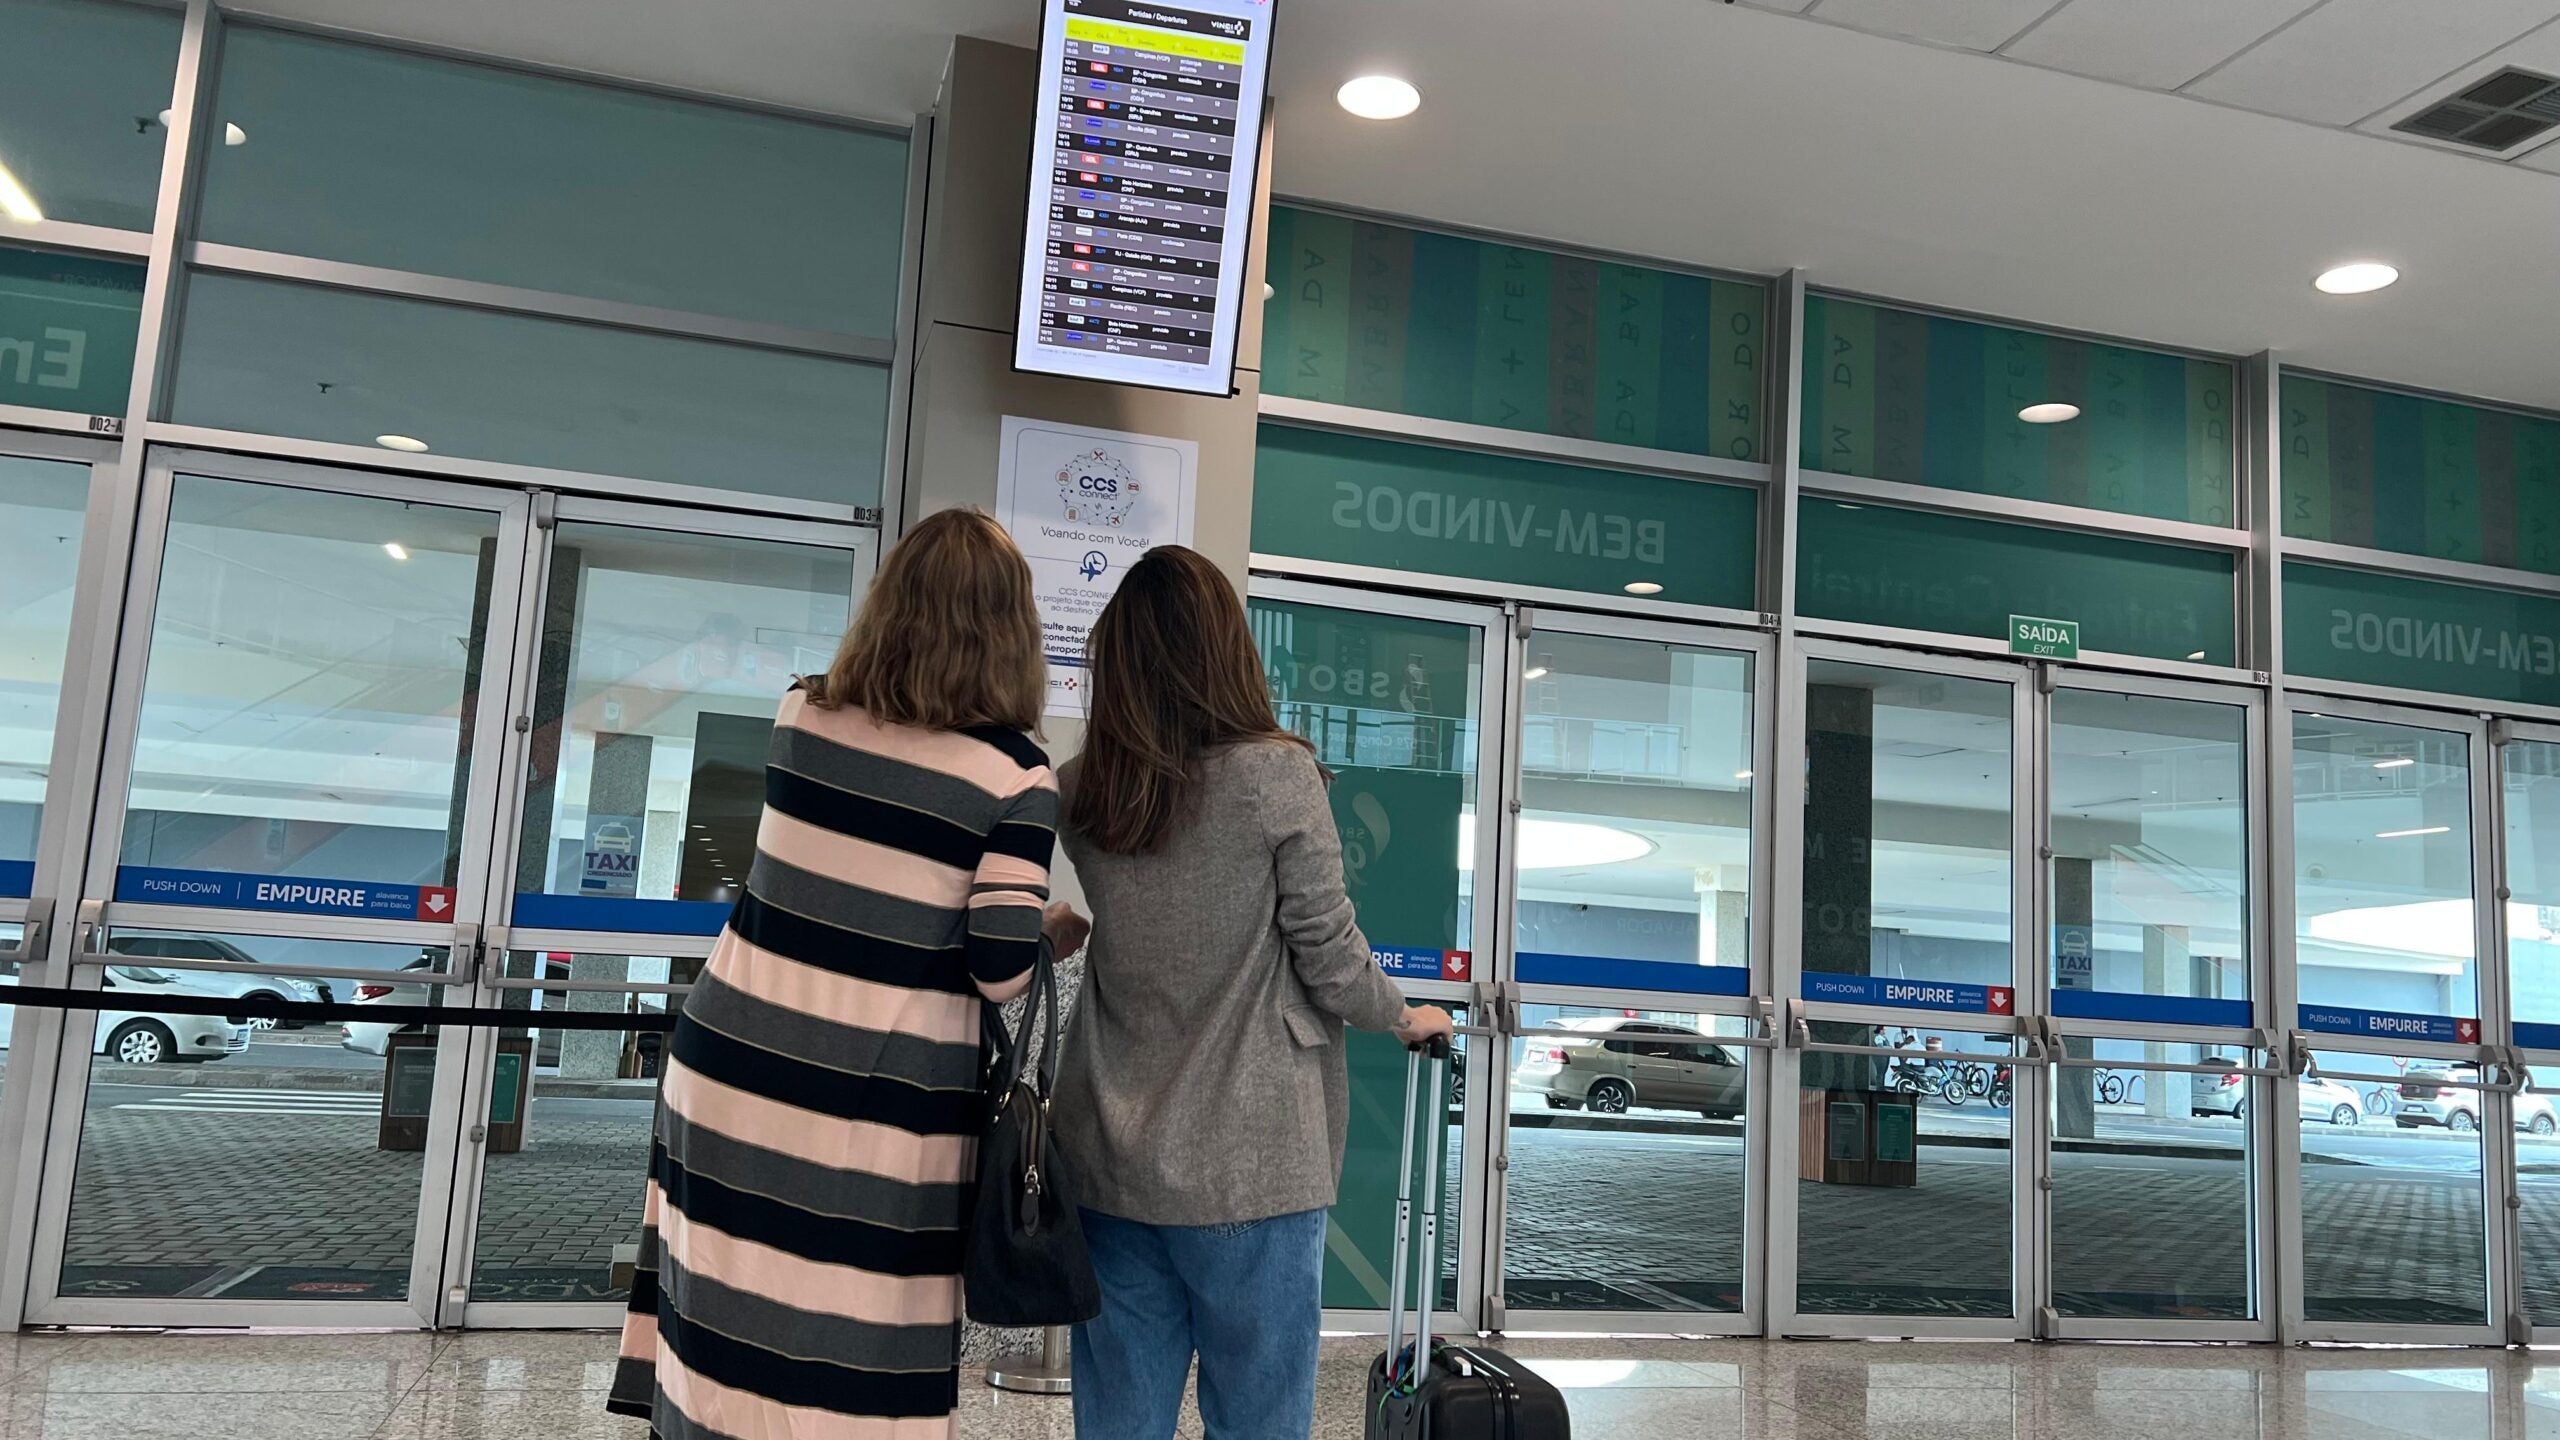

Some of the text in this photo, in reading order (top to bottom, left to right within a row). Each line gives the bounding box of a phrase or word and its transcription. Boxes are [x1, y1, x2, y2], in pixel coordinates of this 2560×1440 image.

[89, 416, 123, 433] 002-A
[1079, 475, 1117, 493] CCS
[1079, 490, 1118, 501] connect
[1041, 526, 1150, 548] Voando com Você!
[1058, 587, 1078, 596] CCS
[1066, 624, 1085, 634] aqui
[2018, 623, 2070, 645] SAÍDA
[1043, 633, 1086, 644] conectad
[2033, 644, 2055, 655] EXIT
[585, 852, 637, 872] TAXI
[144, 879, 366, 908] PUSH DOWN EMPURRE
[2058, 955, 2092, 971] TAXI
[1816, 982, 1837, 991] PUSH
[1839, 984, 1865, 994] DOWN
[1886, 984, 1954, 1004] EMPURRE
[2309, 1013, 2327, 1023] PUSH
[2329, 1015, 2351, 1025] DOWN
[2369, 1016, 2428, 1034] EMPURRE
